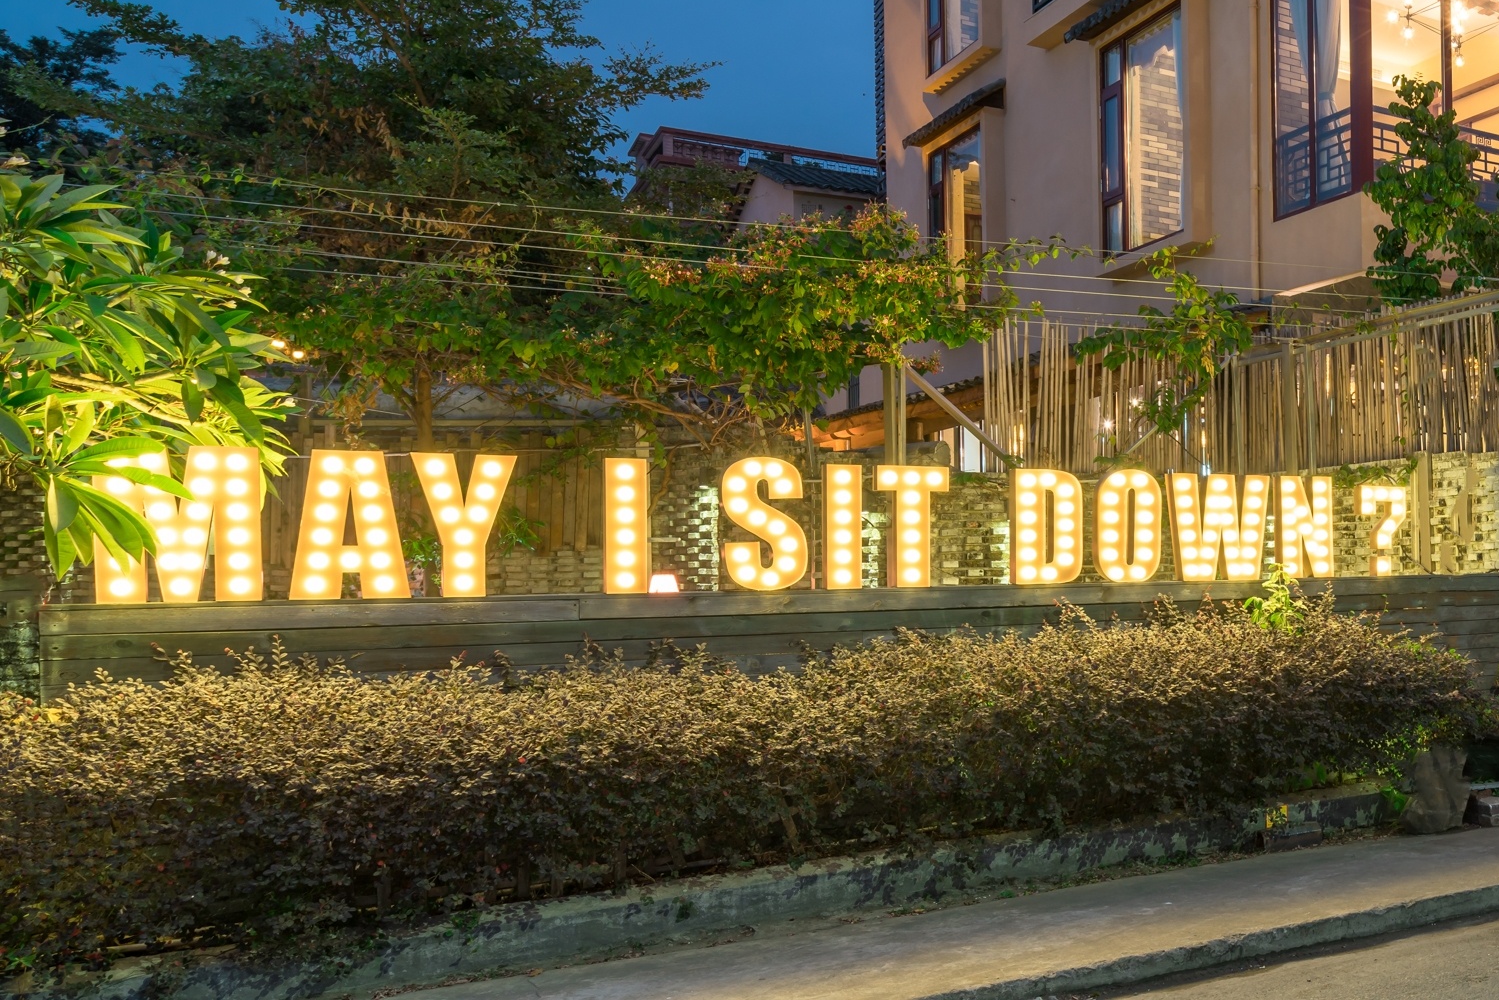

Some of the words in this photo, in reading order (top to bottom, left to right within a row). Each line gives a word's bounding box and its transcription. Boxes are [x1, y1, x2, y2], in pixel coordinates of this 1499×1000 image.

[93, 446, 517, 604] MAY
[604, 457, 648, 594] I
[721, 456, 950, 591] SIT
[1009, 469, 1335, 586] DOWN
